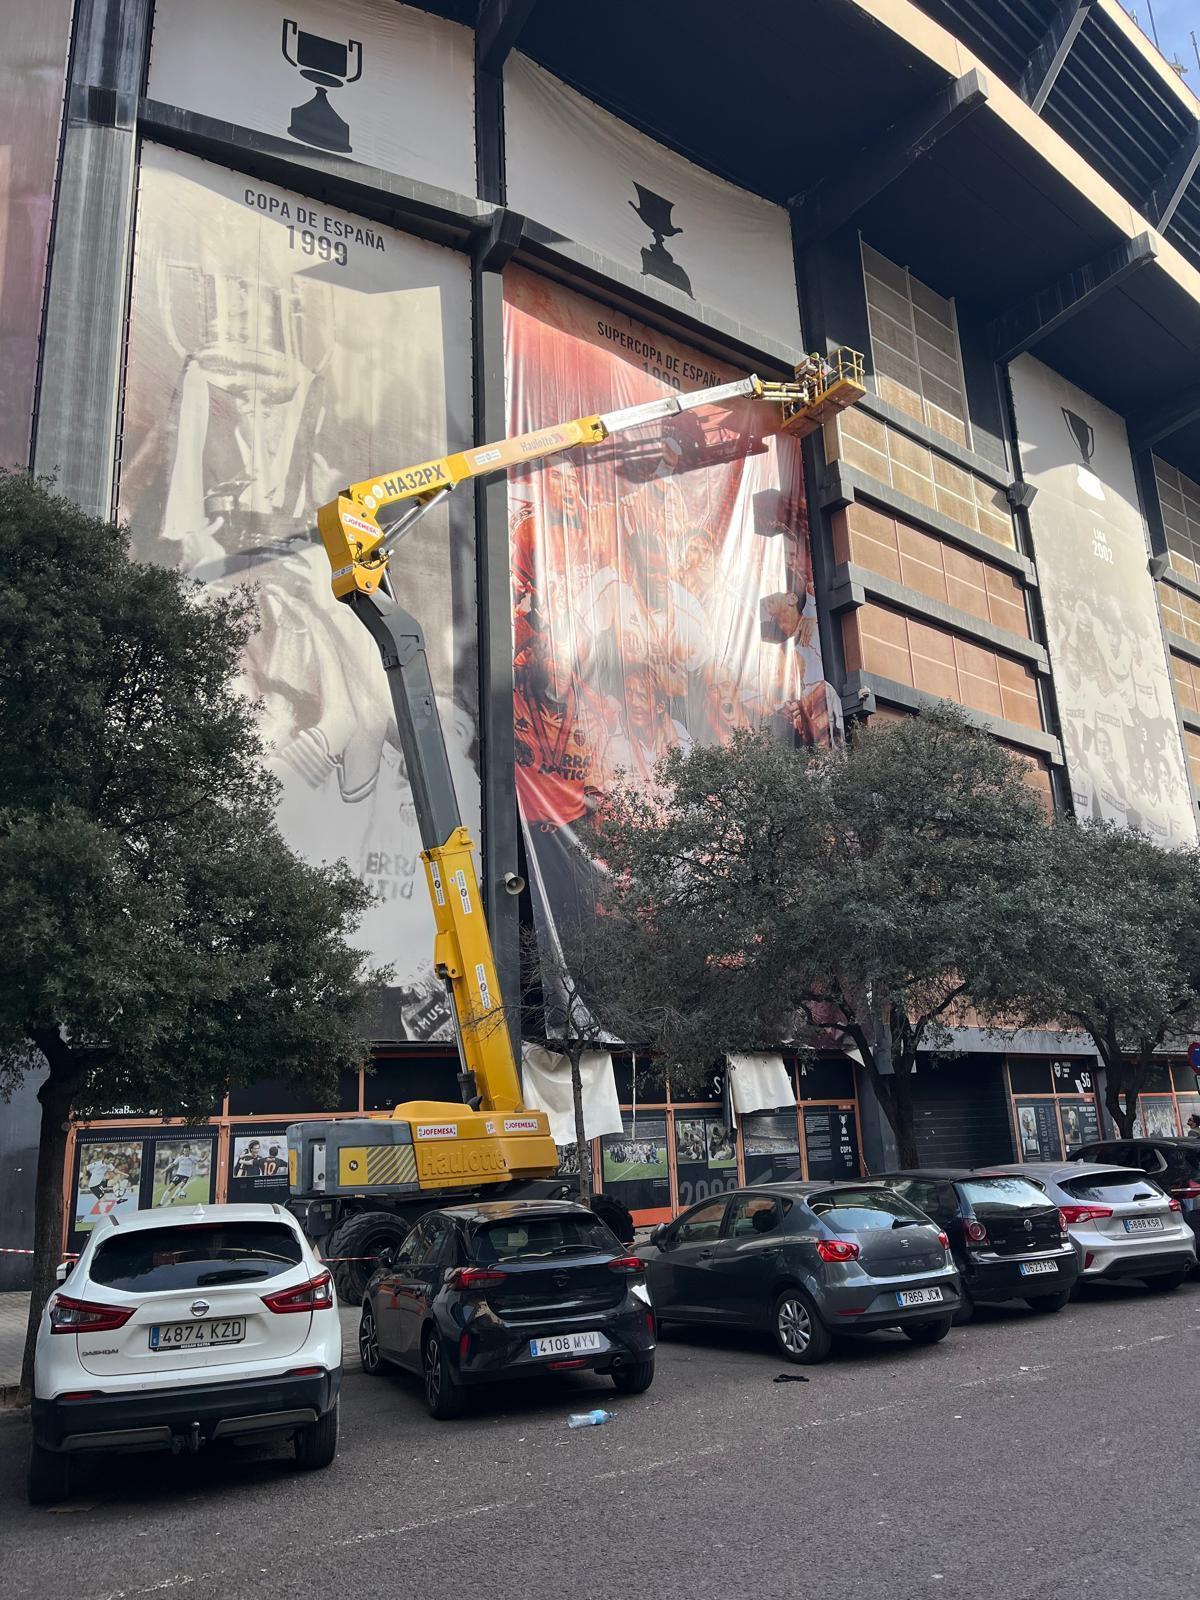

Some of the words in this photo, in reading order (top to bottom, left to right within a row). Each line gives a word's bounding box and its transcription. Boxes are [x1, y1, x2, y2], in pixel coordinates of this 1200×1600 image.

[244, 189, 291, 219] COPA
[296, 207, 318, 229] DE
[323, 216, 386, 252] ESPAÑA
[286, 225, 348, 266] 1999
[597, 321, 663, 364] SUPERCOPA
[665, 354, 680, 374] DE
[520, 435, 554, 453] Haulotte
[383, 463, 447, 498] HA32PX
[1091, 539, 1115, 565] 2002
[1080, 1072, 1091, 1088] S6
[422, 1127, 454, 1136] JOFEMESA
[508, 1121, 535, 1129] JOFEMESA
[263, 1161, 277, 1175] 10
[421, 1144, 507, 1176] Haulotte
[1129, 1219, 1147, 1229] 5888
[1148, 1218, 1162, 1228] KSR
[1025, 1263, 1043, 1274] 0623
[1043, 1260, 1057, 1271] FGN
[902, 1292, 924, 1304] 7869
[927, 1289, 942, 1301] JCW
[162, 1325, 205, 1343] 4874
[210, 1321, 242, 1339] KZD
[539, 1337, 570, 1353] 4108
[574, 1334, 596, 1349] MYV
[82, 1349, 119, 1357] QASHQAI
